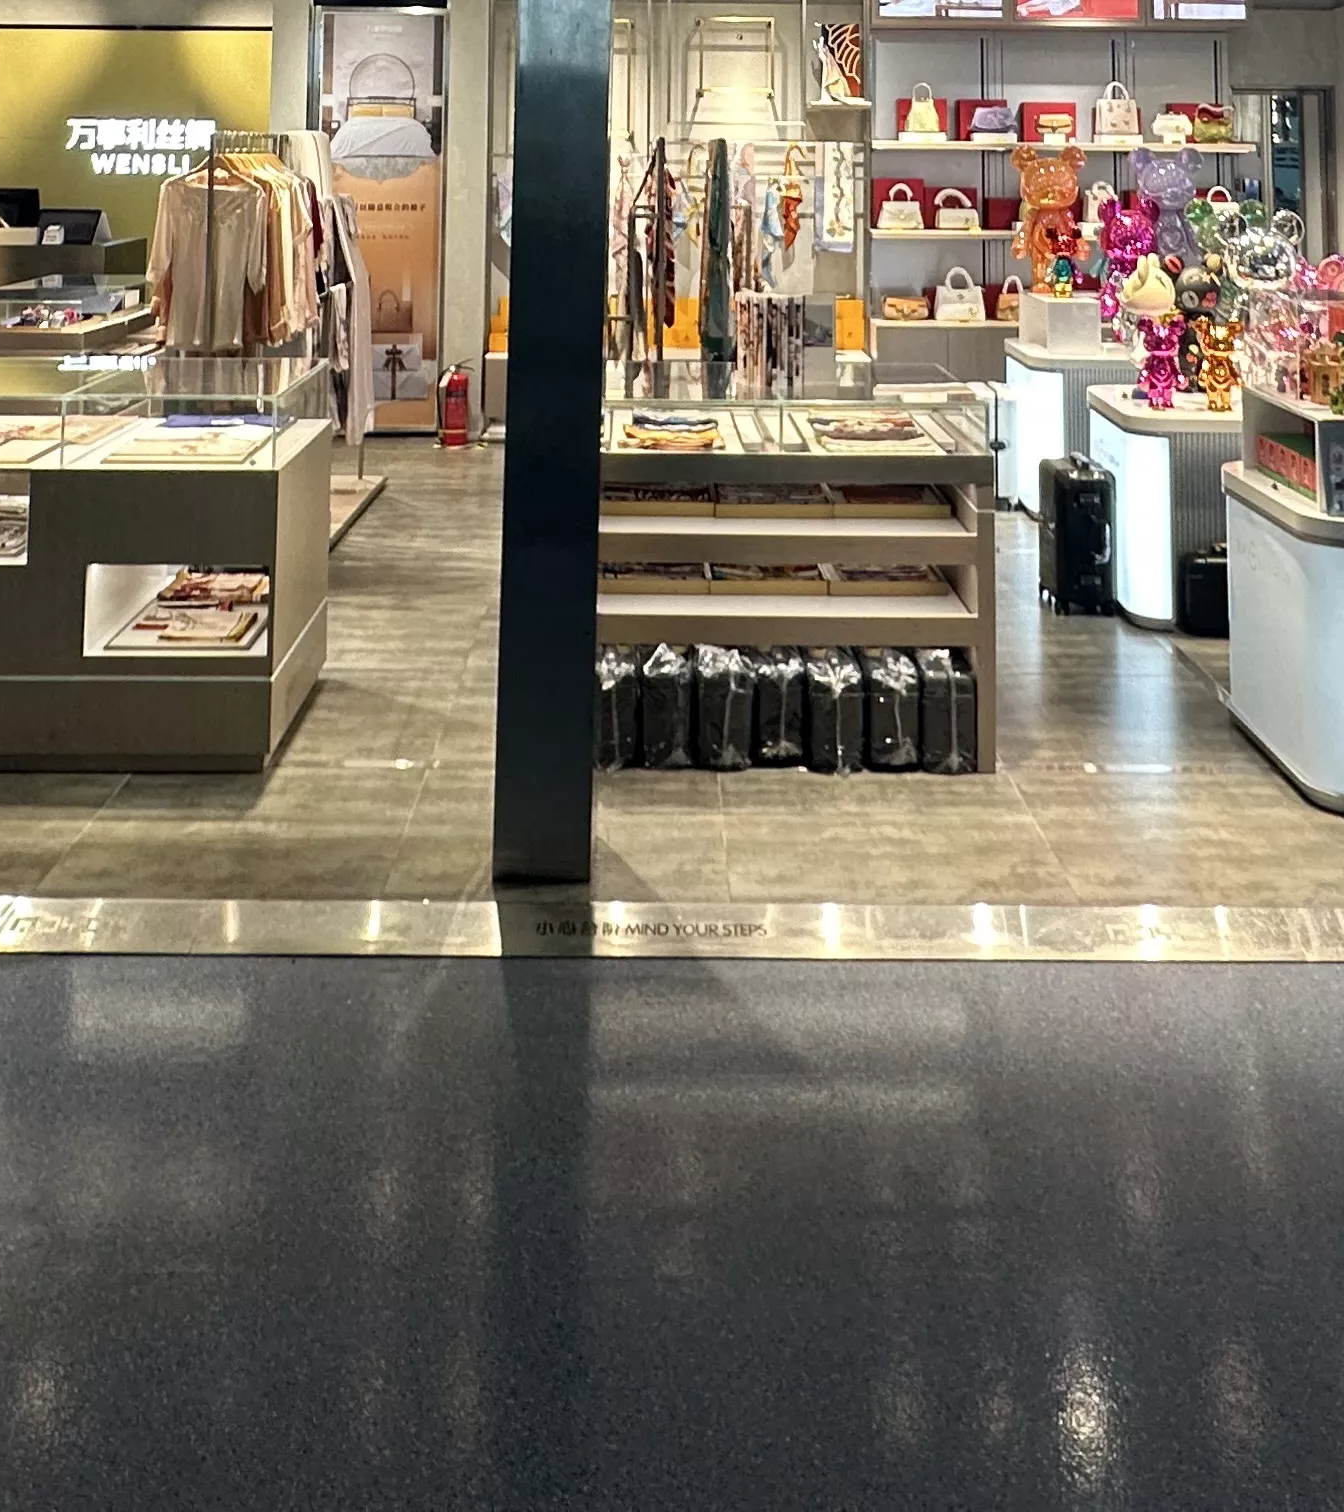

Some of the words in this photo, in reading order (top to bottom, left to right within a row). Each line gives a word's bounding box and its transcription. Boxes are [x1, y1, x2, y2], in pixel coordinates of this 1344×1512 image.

[90, 152, 190, 175] WENSLI
[625, 922, 670, 937] MIND
[672, 922, 719, 938] YOUR
[722, 922, 768, 938] STEPS
